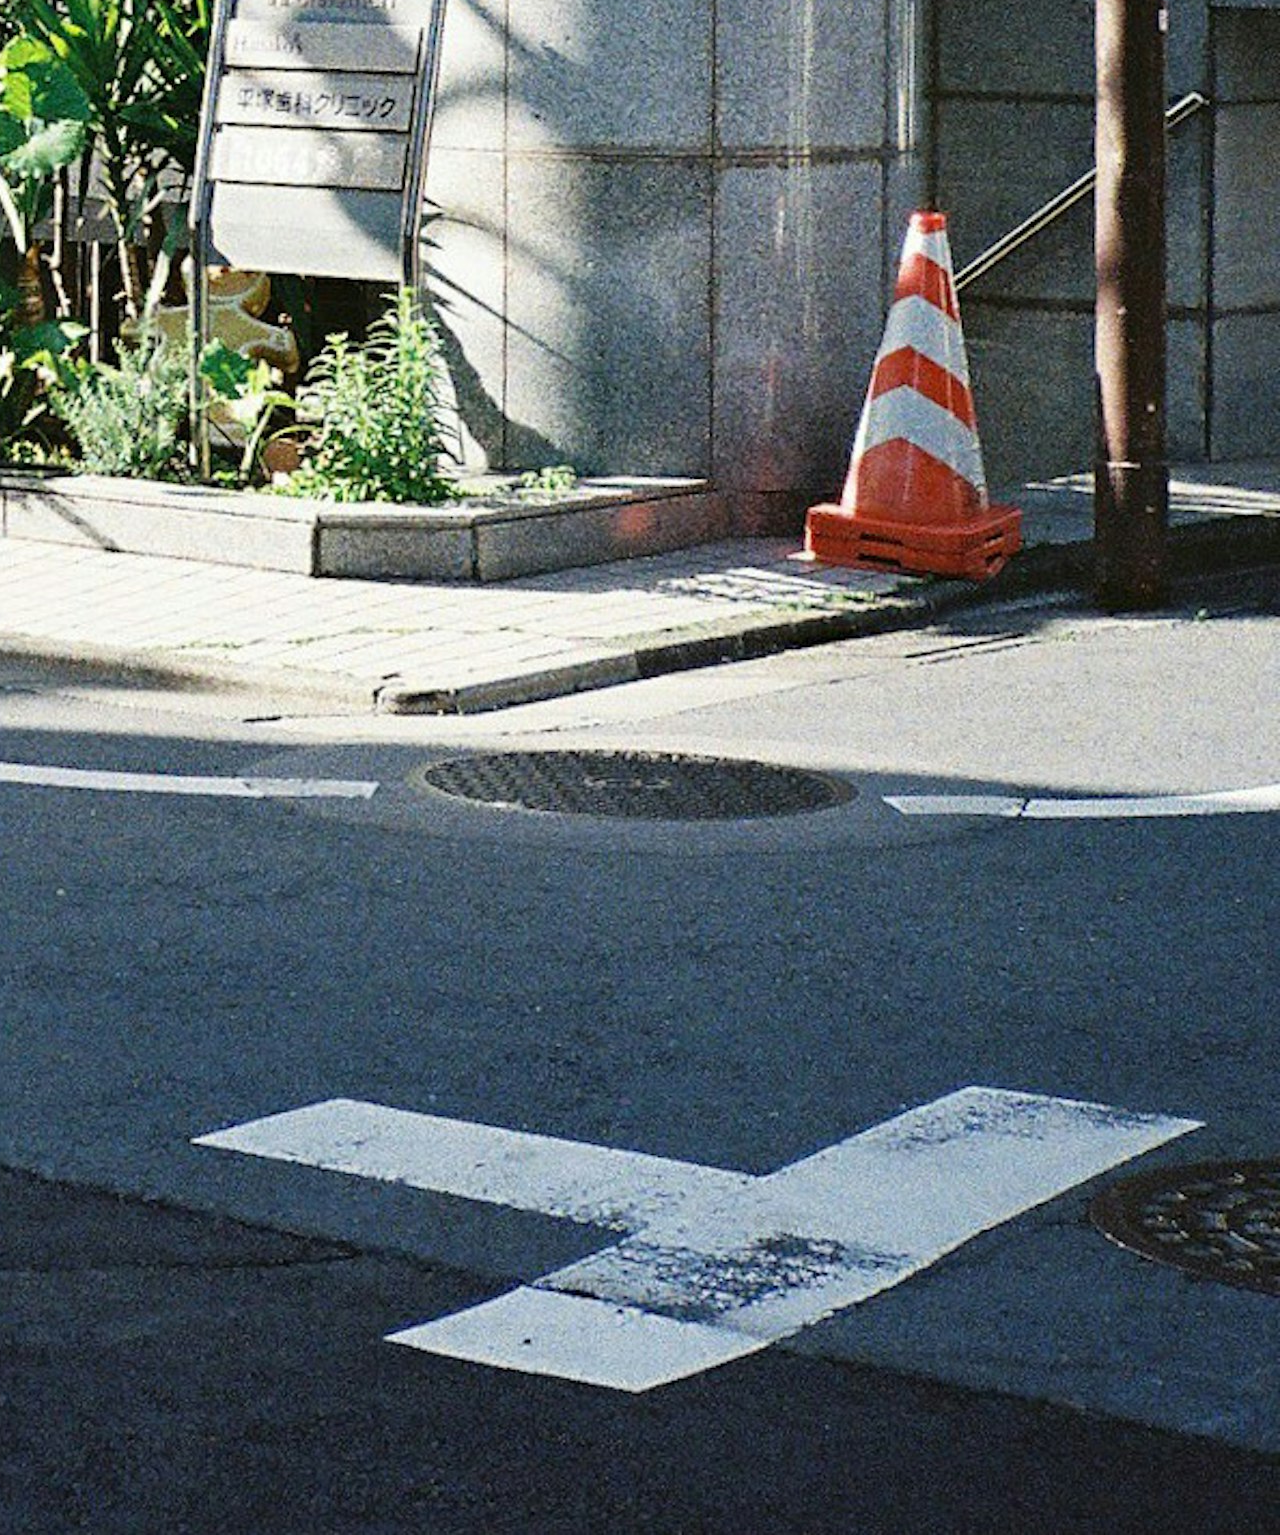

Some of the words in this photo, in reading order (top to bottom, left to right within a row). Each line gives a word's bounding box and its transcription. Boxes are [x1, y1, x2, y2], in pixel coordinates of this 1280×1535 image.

[237, 86, 397, 120] 平塚歯科クリニック
